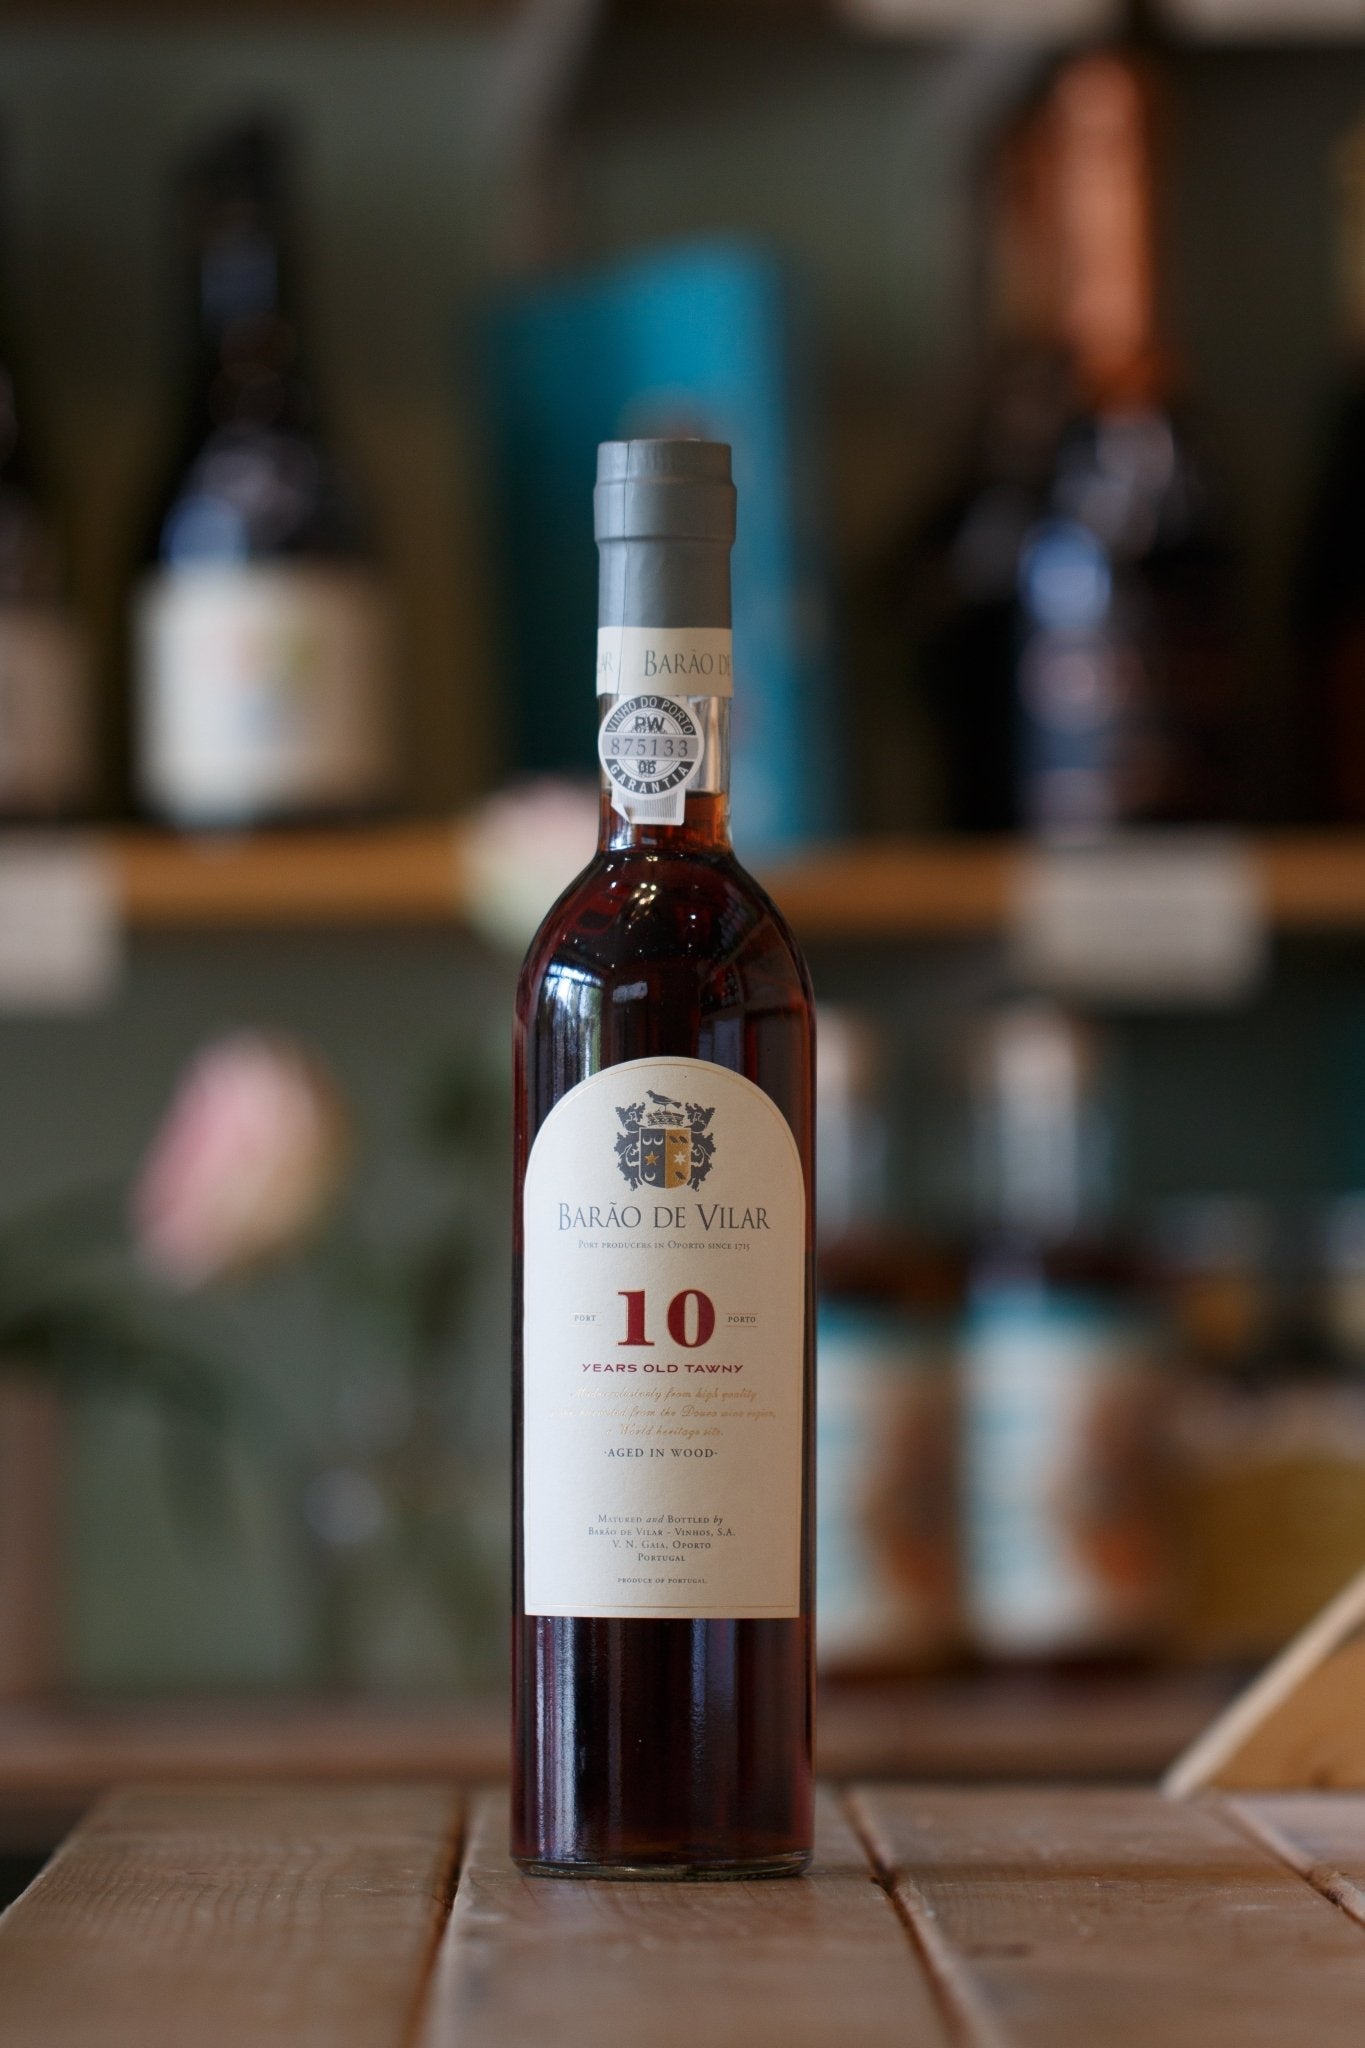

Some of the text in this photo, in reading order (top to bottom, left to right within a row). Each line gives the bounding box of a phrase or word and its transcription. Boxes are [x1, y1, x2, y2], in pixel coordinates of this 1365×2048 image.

[644, 648, 714, 677] BARÃO
[606, 696, 694, 734] VINHO DO PORTO
[611, 738, 688, 757] 875133
[610, 764, 689, 793] GARANTIA
[558, 1202, 771, 1231] BARÃO DE VILAR
[602, 1241, 651, 1249] PRODUCERS
[668, 1240, 705, 1249] OPORTO
[708, 1242, 732, 1250] SINCE
[574, 1314, 596, 1322] PORT
[617, 1288, 716, 1348] 10
[582, 1363, 744, 1374] YEARS OLD TAWNY
[660, 1407, 677, 1417] the
[650, 1448, 664, 1457] IN
[645, 1515, 665, 1524] and
[667, 1515, 710, 1524] BOTTLED
[712, 1515, 723, 1526] by
[636, 1528, 663, 1536] VILAR
[675, 1528, 714, 1538] VINHOS,
[717, 1528, 736, 1537] S.A.
[672, 1540, 711, 1549] OPORTO
[638, 1552, 686, 1562] PORTUGAL
